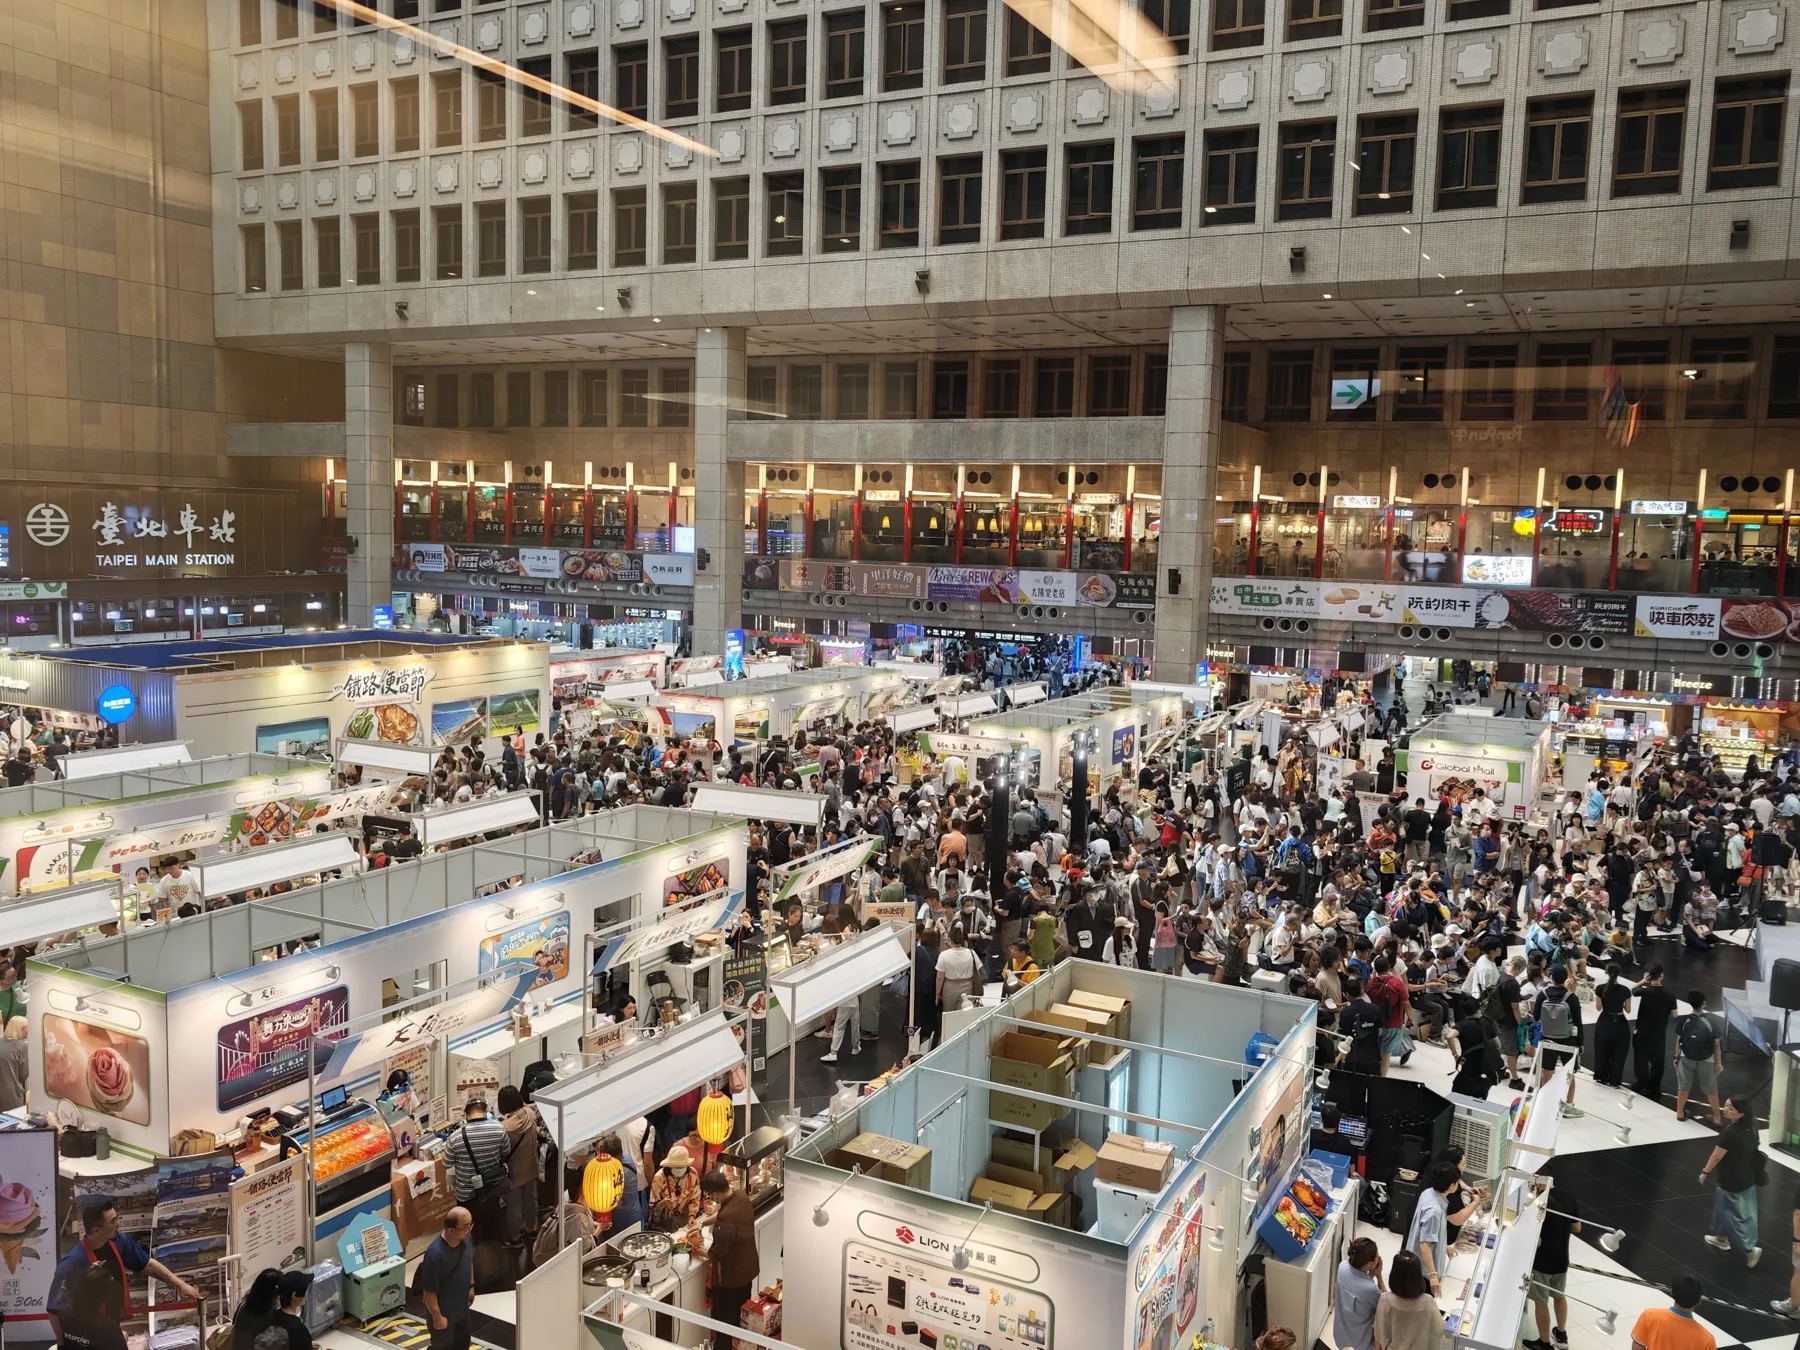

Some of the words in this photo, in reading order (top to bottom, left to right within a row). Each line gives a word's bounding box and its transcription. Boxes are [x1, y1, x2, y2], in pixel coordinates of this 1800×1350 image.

[92, 502, 236, 548] 臺北車站
[96, 555, 137, 566] TAIPEI
[146, 555, 178, 566] MAIN
[186, 554, 234, 565] STATION
[1032, 587, 1066, 599] 太陽堂老店
[1243, 595, 1280, 604] 波士頓派
[1285, 597, 1315, 606] 專賣店
[1408, 597, 1471, 612] 阮的肉干
[774, 620, 795, 629] Breeze
[1649, 611, 1715, 628] 快車肉乾
[344, 667, 424, 701] 鐵路便當節
[1674, 679, 1713, 689] Breeze
[1436, 764, 1470, 773] Global
[1473, 766, 1494, 775] Mall
[45, 850, 80, 874] BAKERES
[919, 1235, 949, 1252] LION
[14, 1296, 43, 1307] 30th
